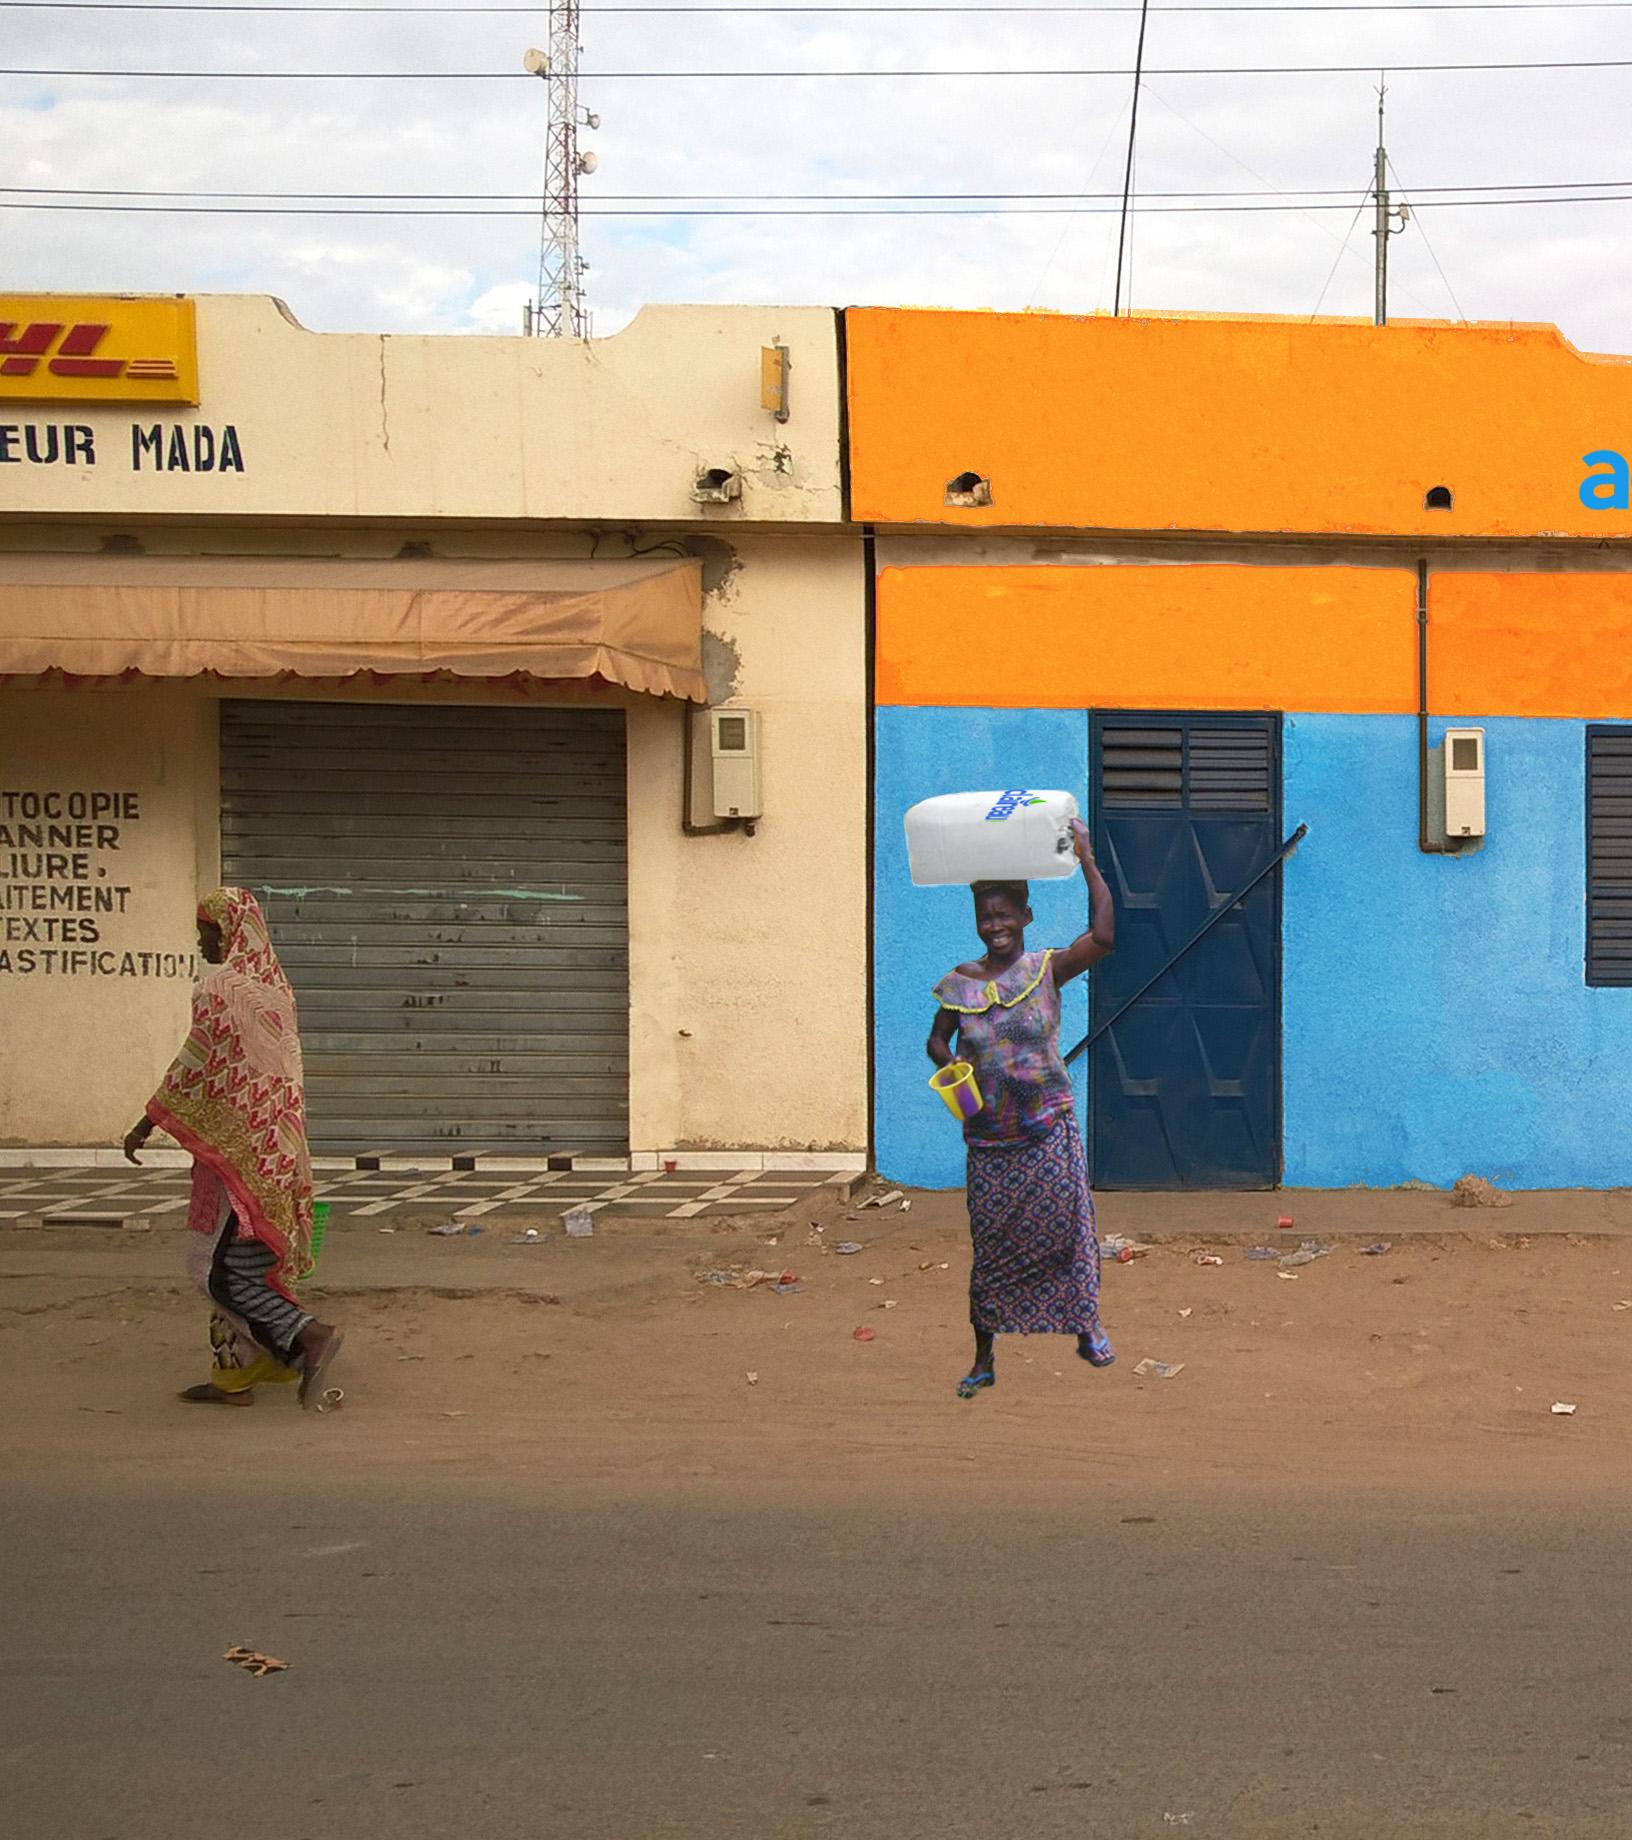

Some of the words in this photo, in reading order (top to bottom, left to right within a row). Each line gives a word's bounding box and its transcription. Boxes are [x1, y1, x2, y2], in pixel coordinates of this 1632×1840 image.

[0, 424, 95, 465] EUR
[132, 424, 245, 472] MADA
[0, 885, 132, 913] ITEMENT
[0, 916, 101, 943] EXTES
